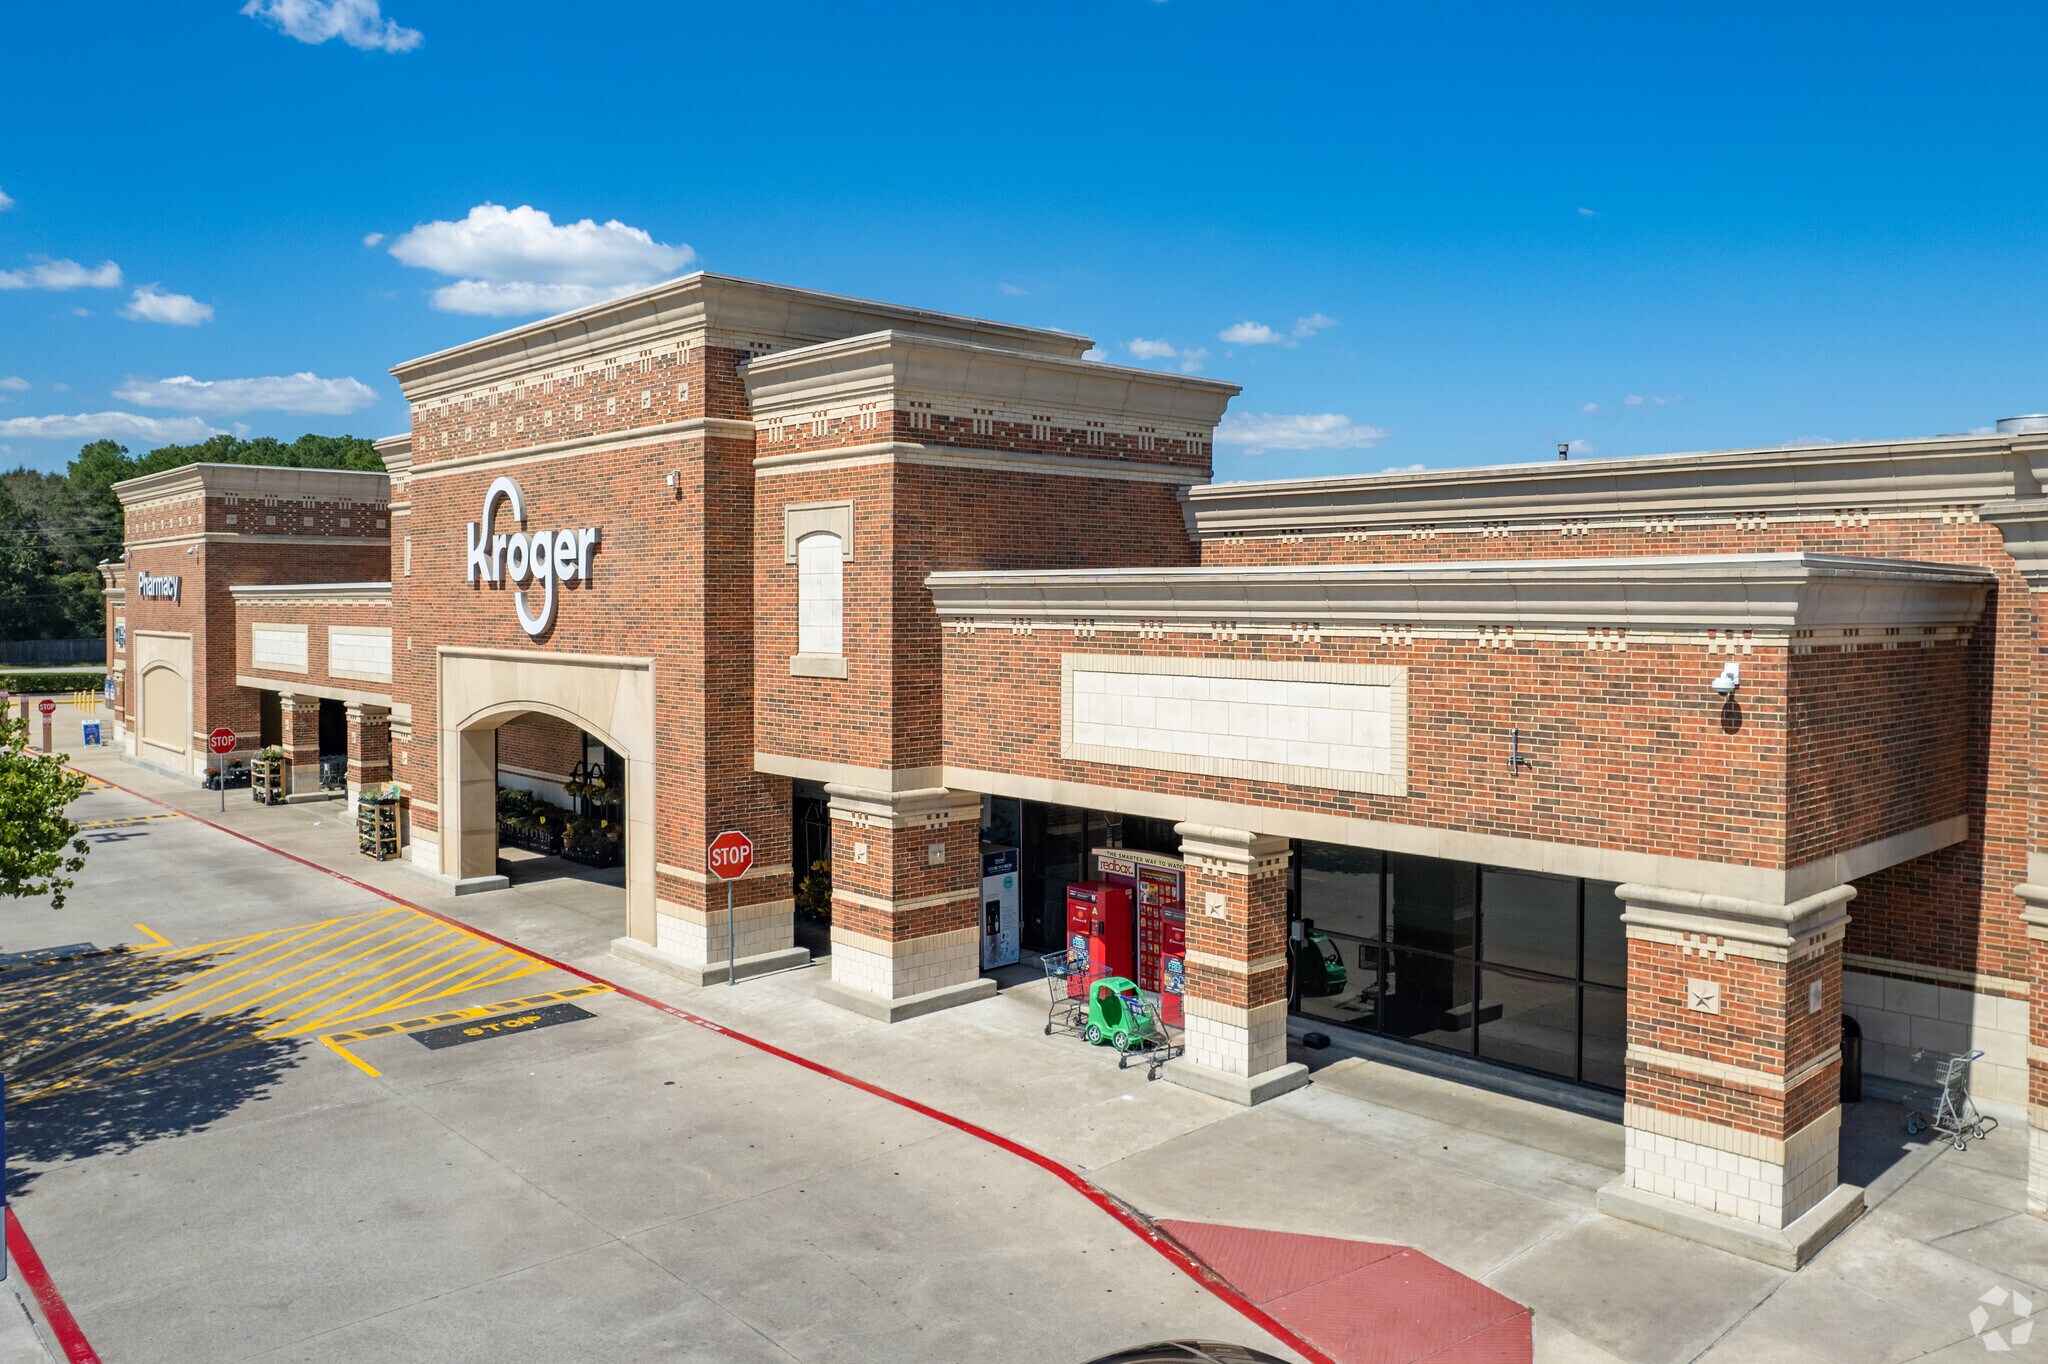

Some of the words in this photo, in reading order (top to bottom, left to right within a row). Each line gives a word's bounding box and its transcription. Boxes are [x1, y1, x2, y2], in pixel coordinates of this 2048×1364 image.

[467, 476, 602, 635] Kroger
[138, 571, 181, 602] Pharmacy
[39, 703, 56, 711] STOP
[211, 735, 235, 747] STOP
[711, 845, 750, 867] STOP
[1118, 853, 1143, 862] SMARTER
[1091, 907, 1098, 915] A
[1168, 962, 1183, 972] FREE
[463, 1015, 541, 1036] STOP
